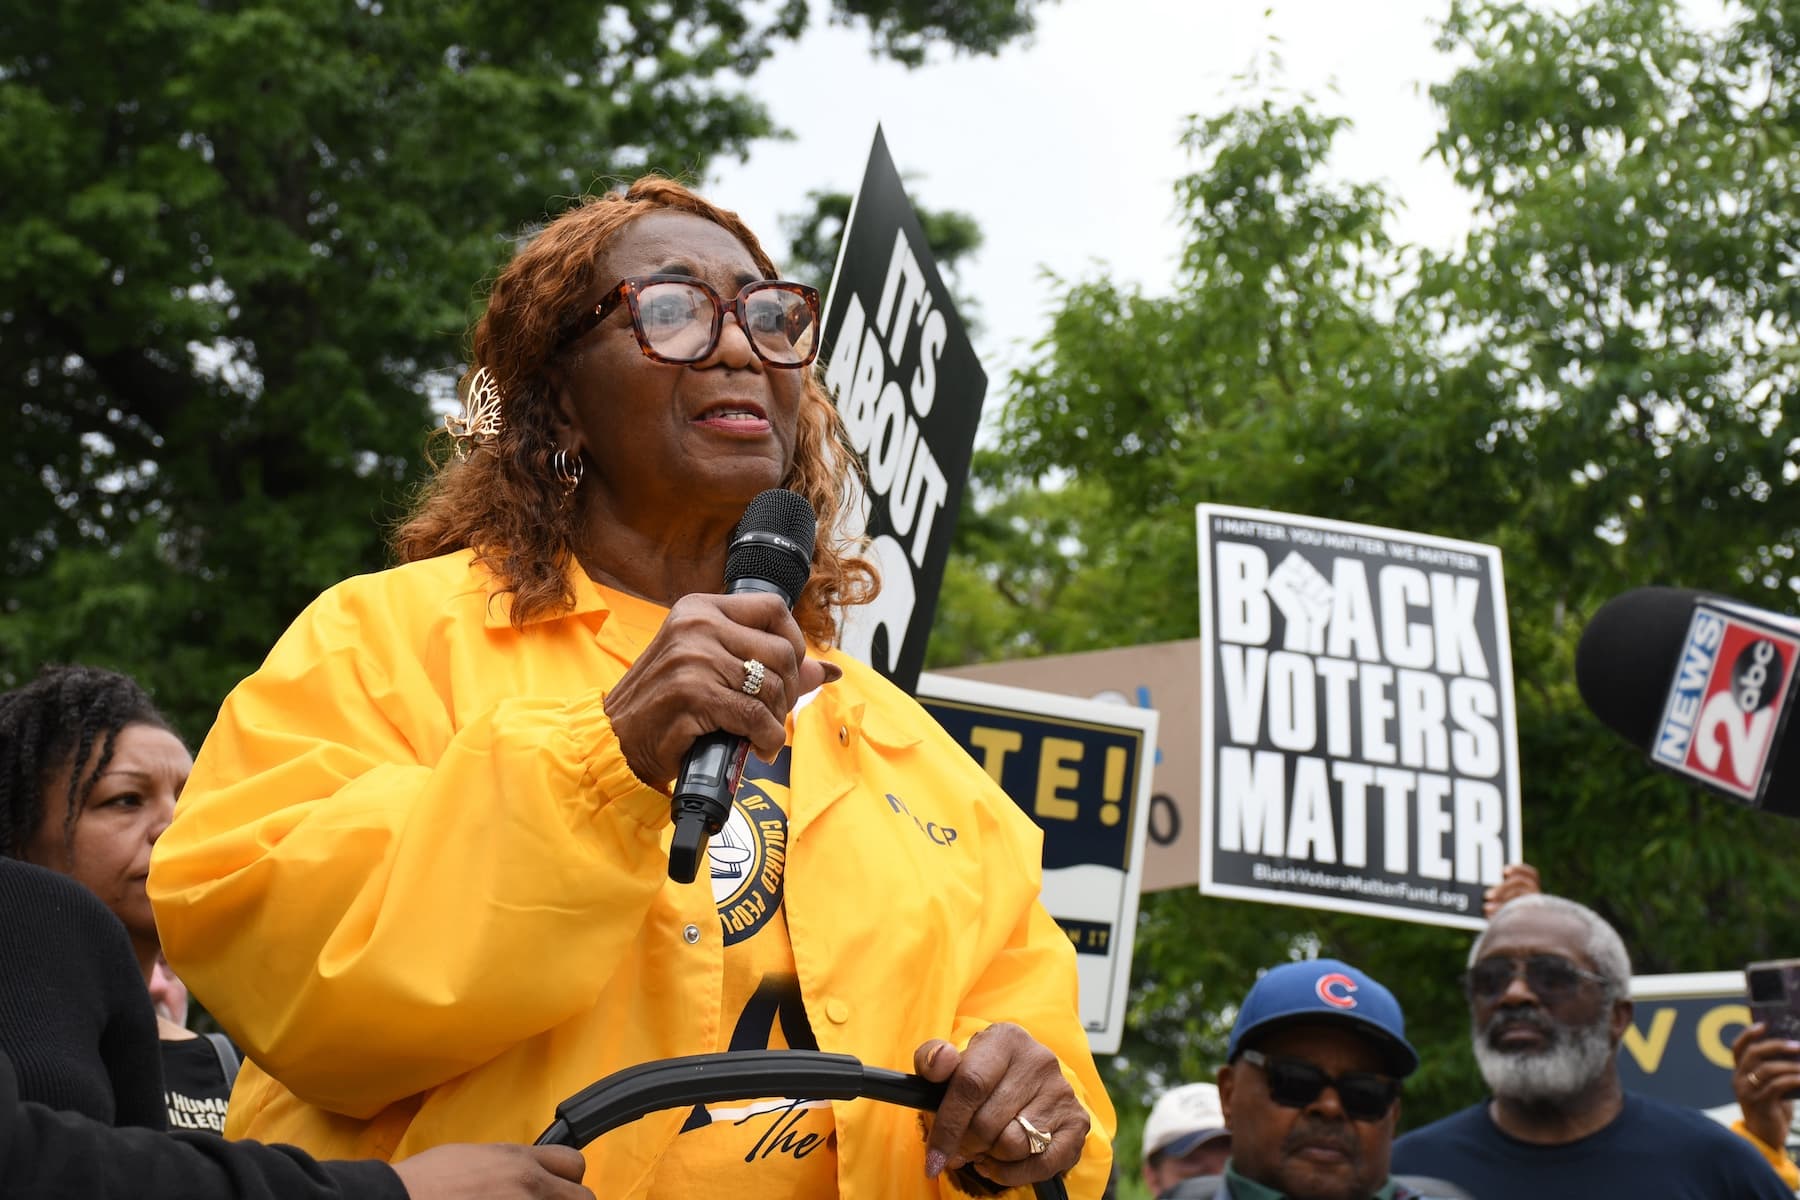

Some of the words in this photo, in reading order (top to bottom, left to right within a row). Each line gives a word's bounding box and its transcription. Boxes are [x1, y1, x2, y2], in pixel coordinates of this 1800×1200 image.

[875, 227, 947, 418] IT'S
[825, 291, 948, 569] ABOUT
[1288, 527, 1323, 546] YOU
[1388, 542, 1416, 560] WE
[1220, 643, 1500, 778] VOTERS
[1655, 613, 1724, 764] NEWS
[1695, 690, 1774, 786] 2
[1741, 639, 1775, 713] abc
[741, 794, 770, 811] OF
[969, 724, 1128, 827] TE!
[1219, 746, 1504, 887] MATTER
[758, 819, 786, 895] COLORED
[1252, 862, 1469, 912] BlackVotersMatterFund.org
[719, 889, 767, 935] PEOPL
[1315, 972, 1358, 1009] C
[1622, 1004, 1753, 1074] VO
[168, 1107, 226, 1133] ILLEG
[733, 1098, 826, 1164] The
